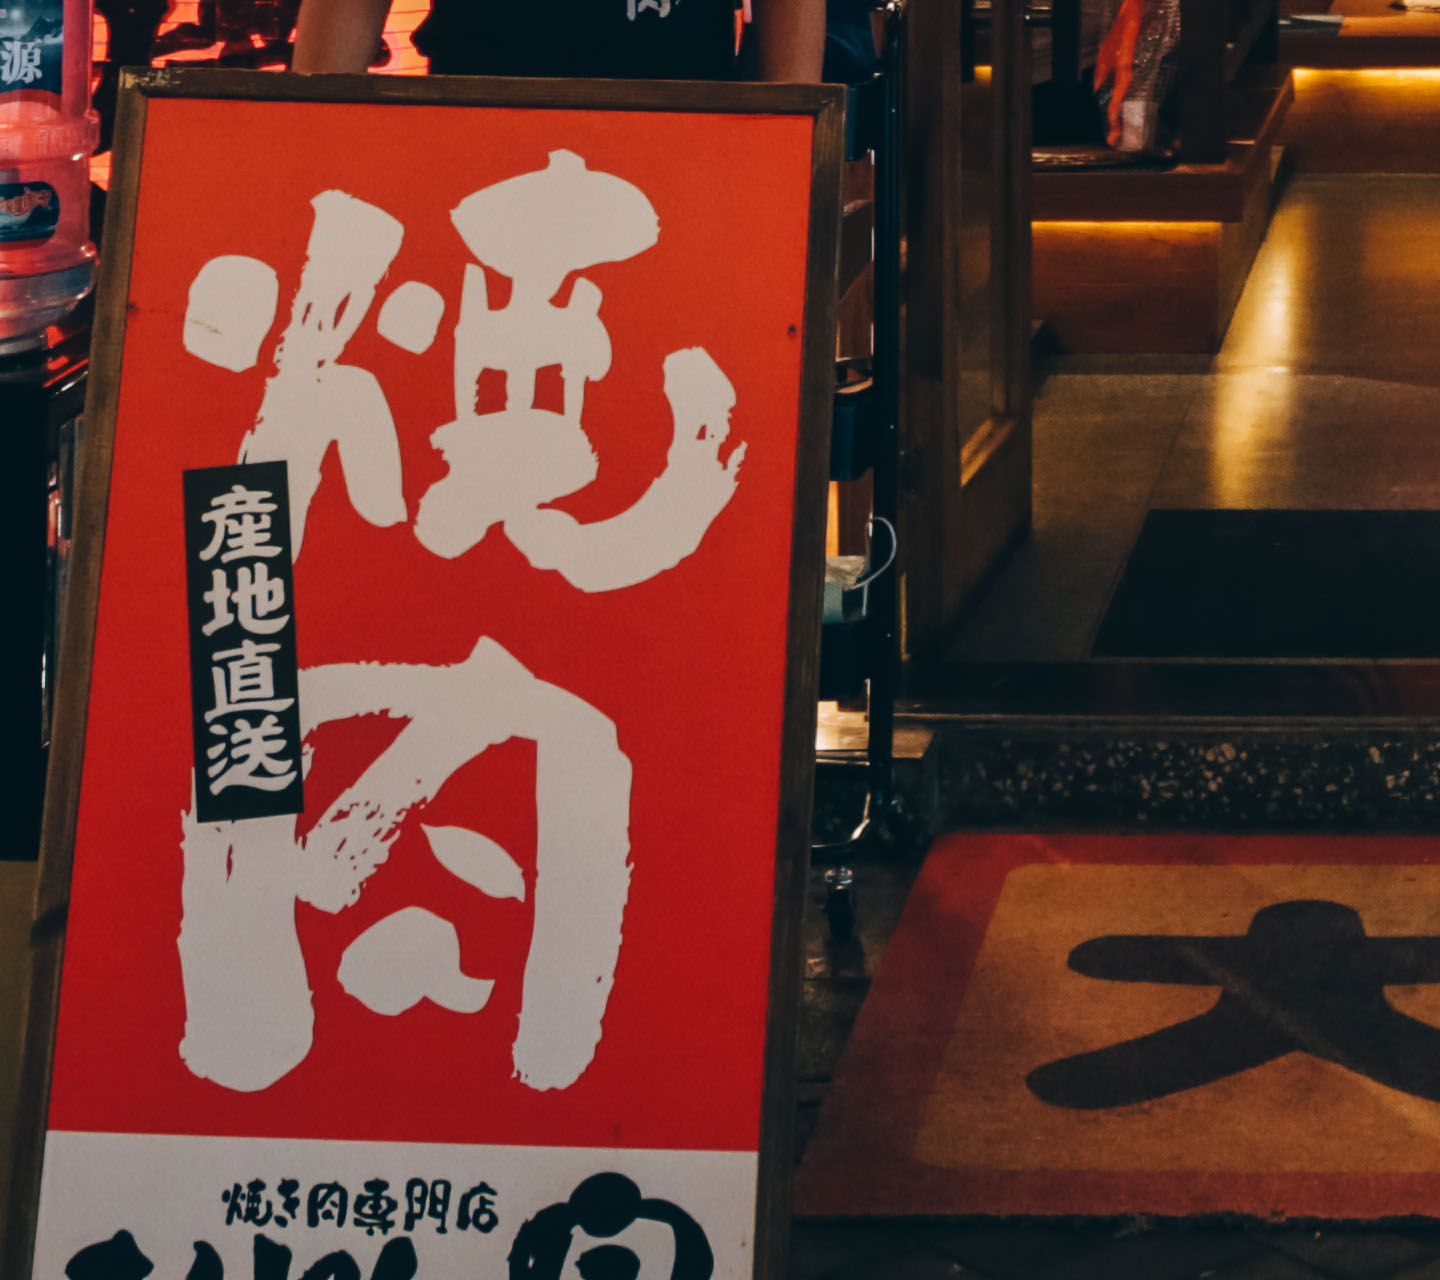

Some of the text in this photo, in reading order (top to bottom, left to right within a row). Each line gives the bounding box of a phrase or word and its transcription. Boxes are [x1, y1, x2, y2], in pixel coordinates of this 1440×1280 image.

[198, 485, 299, 795] 産地直送
[221, 1178, 500, 1236] 焼き肉専門店
